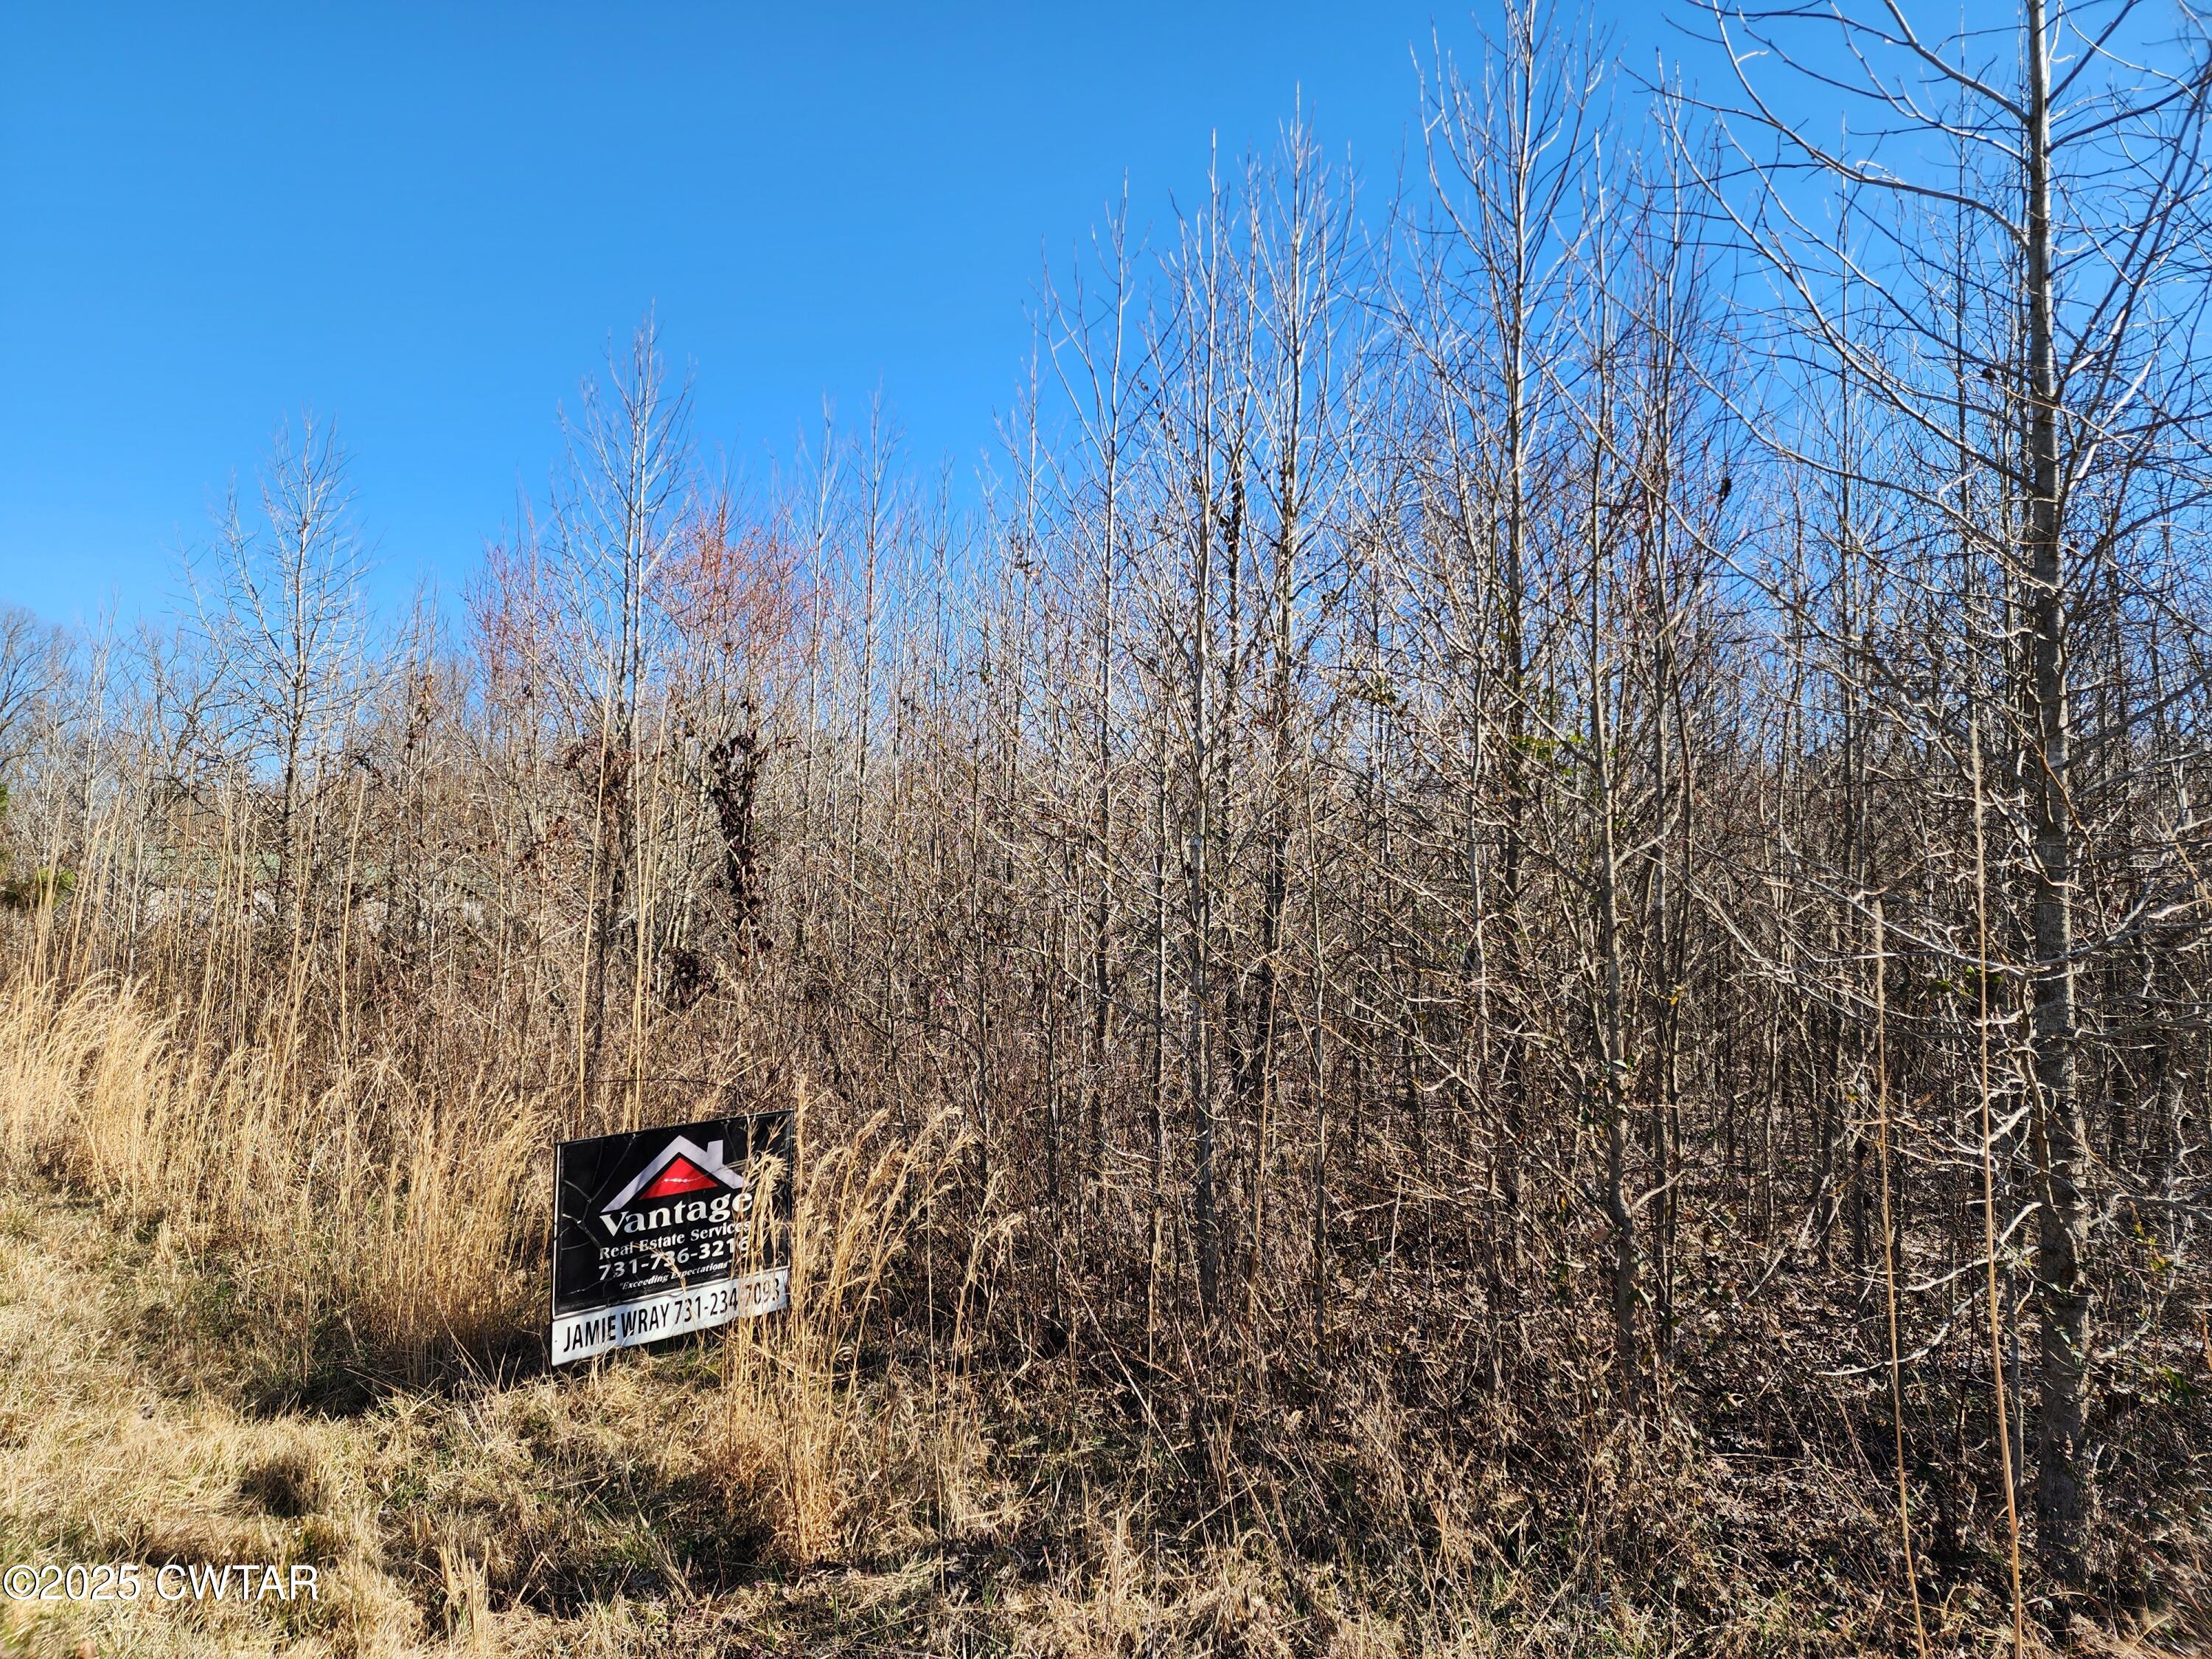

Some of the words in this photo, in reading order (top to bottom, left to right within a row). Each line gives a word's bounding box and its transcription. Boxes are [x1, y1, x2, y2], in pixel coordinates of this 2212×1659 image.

[599, 1192, 753, 1237] Vantage
[599, 1245, 634, 1260] Real
[639, 1233, 686, 1252] Estate
[690, 1221, 751, 1242] Services
[599, 1235, 751, 1281] 731-736-3216
[619, 1273, 669, 1291] "Exceeding
[563, 1315, 616, 1352] JAMIE
[621, 1302, 670, 1338] WRAY
